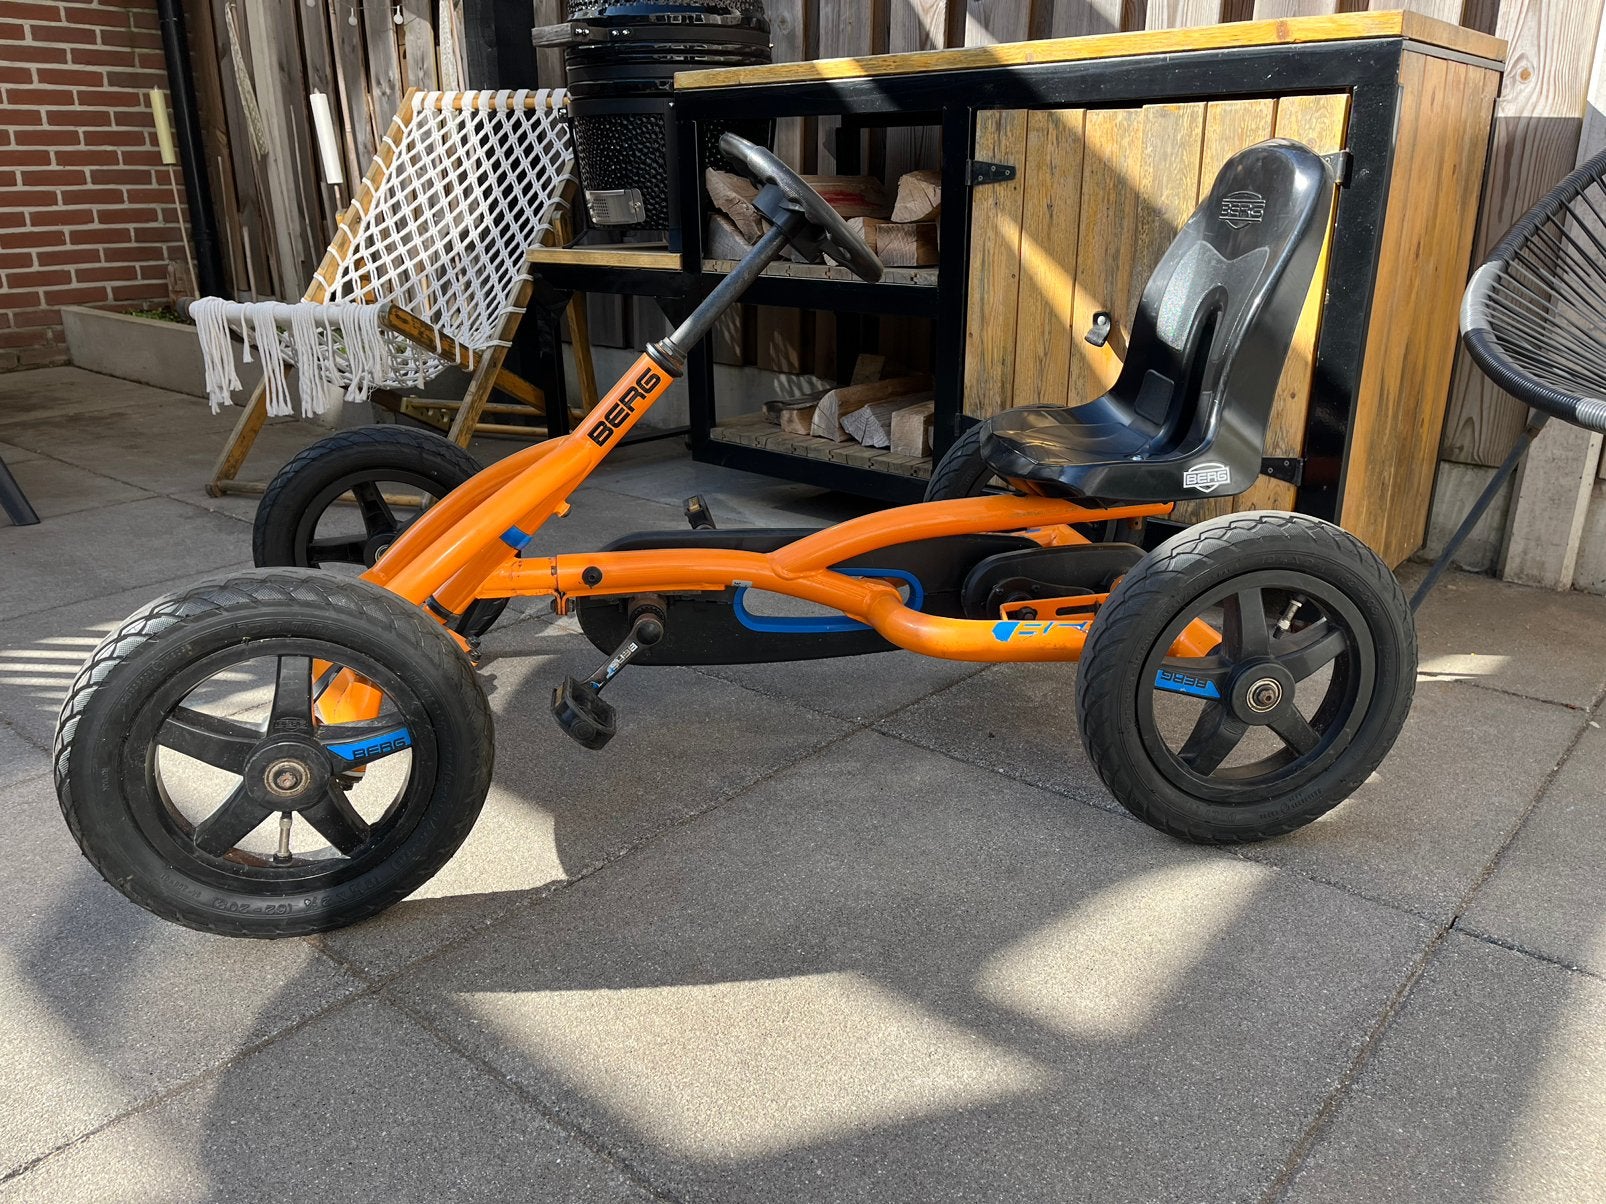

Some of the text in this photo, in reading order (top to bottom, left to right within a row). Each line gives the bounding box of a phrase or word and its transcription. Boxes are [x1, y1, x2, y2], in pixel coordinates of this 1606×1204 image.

[1221, 201, 1265, 218] BERG
[587, 367, 662, 447] BERG
[1186, 470, 1227, 485] BERG
[1160, 671, 1208, 689] BERG
[352, 737, 406, 760] BERG
